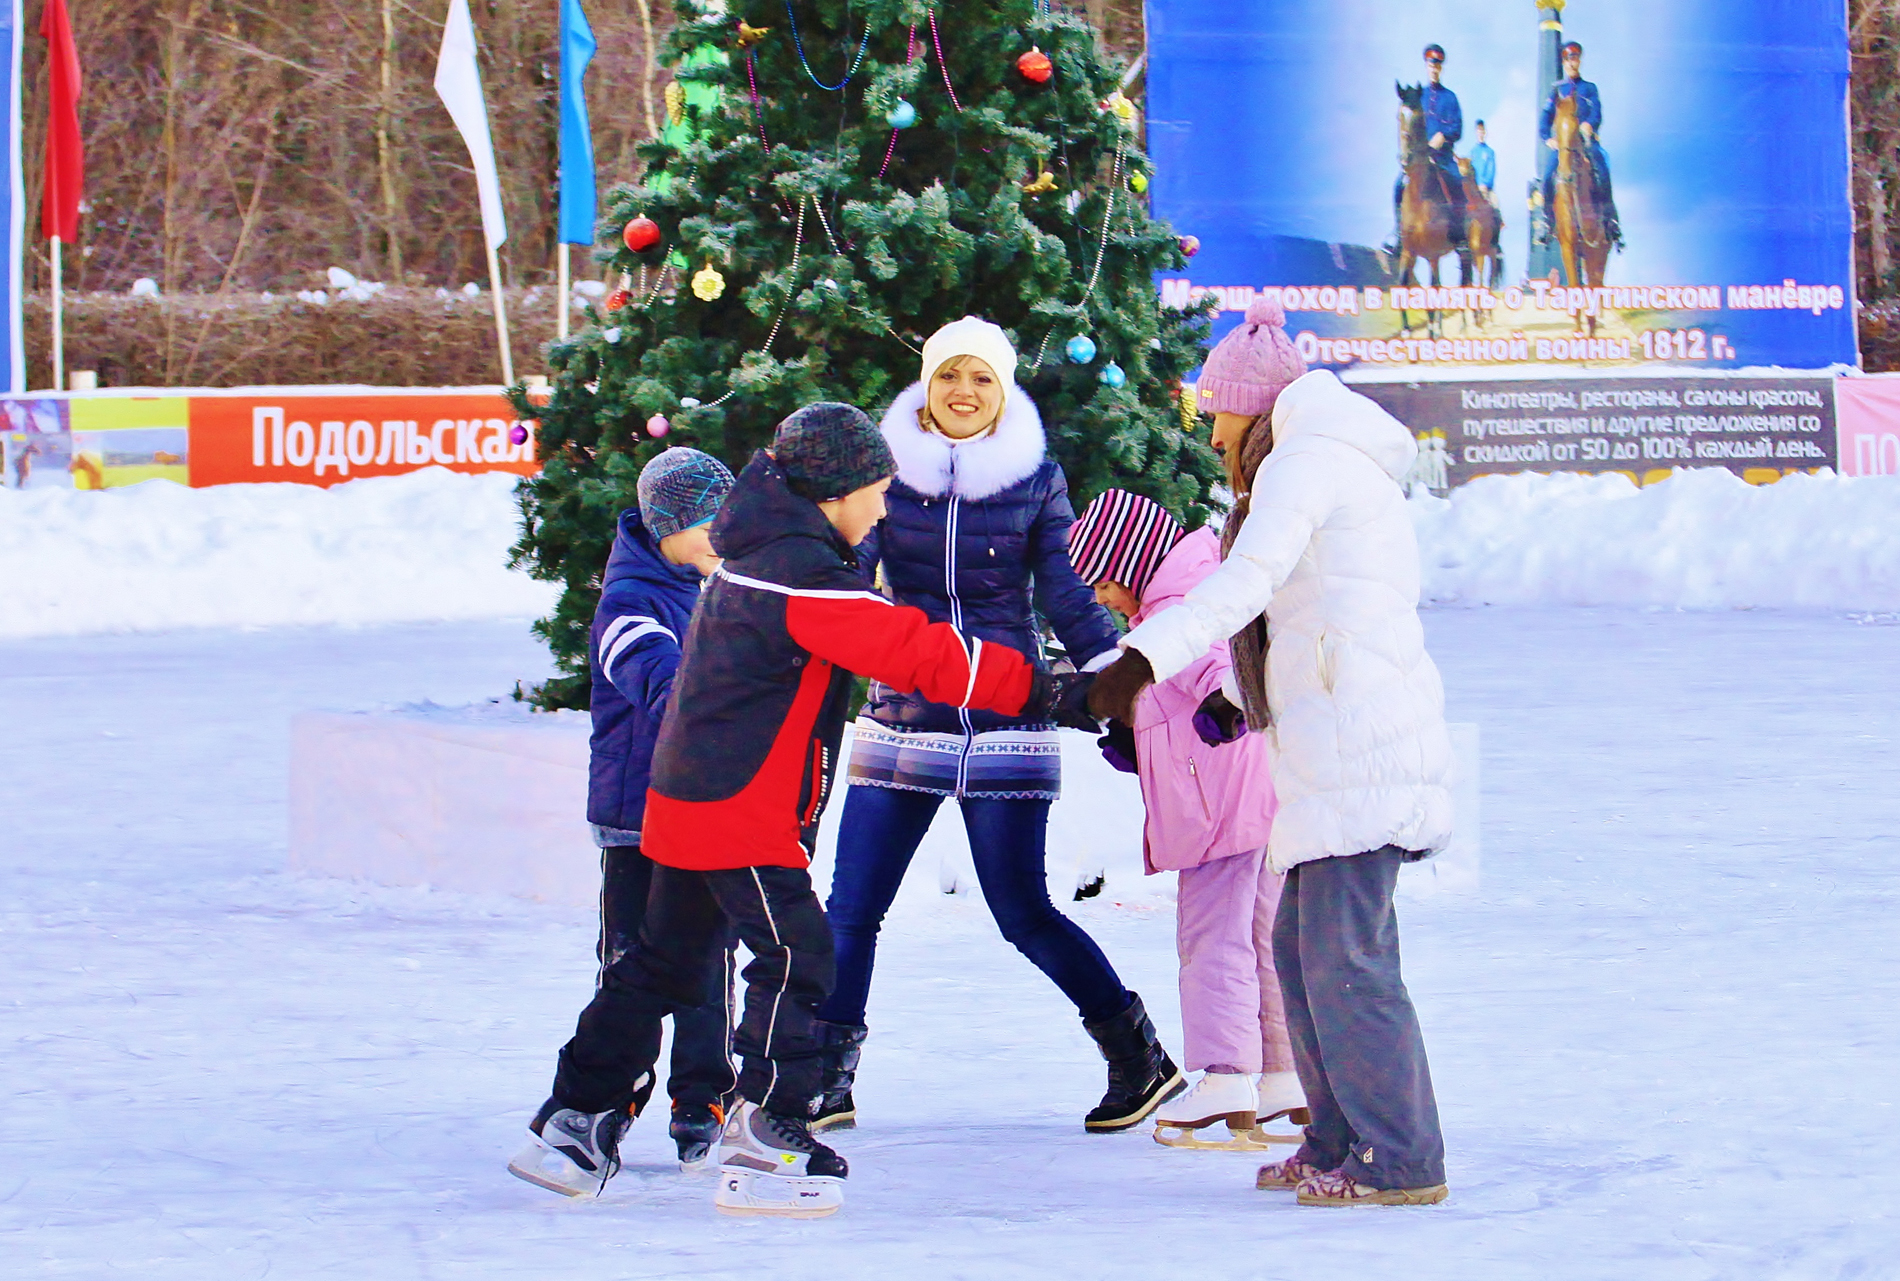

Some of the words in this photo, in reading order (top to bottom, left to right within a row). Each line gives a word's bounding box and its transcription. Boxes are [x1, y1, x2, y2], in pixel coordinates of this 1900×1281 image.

[1364, 286, 1384, 310] в
[1390, 286, 1497, 311] память
[1503, 285, 1523, 310] о
[1530, 279, 1722, 316] Тарутинском
[1727, 279, 1845, 317] манёвре
[1298, 331, 1529, 364] Отечественной
[1535, 332, 1631, 362] войны
[1639, 329, 1707, 362] 1812
[1712, 334, 1736, 361] г.
[1581, 389, 1681, 411] рестораны,
[1684, 390, 1748, 407] салоны
[1749, 390, 1825, 409] красоты,
[1463, 417, 1590, 440] путешествия
[1591, 417, 1606, 434] и
[1607, 415, 1674, 438] другие
[1675, 415, 1797, 436] предложения
[1798, 415, 1821, 432] со
[1464, 440, 1551, 463] скидкой
[1552, 443, 1579, 461] от
[1581, 438, 1610, 461] 50
[1612, 442, 1640, 460] до
[1641, 437, 1694, 460] 100%
[1696, 436, 1774, 458] каждый
[1775, 440, 1827, 458] день.
